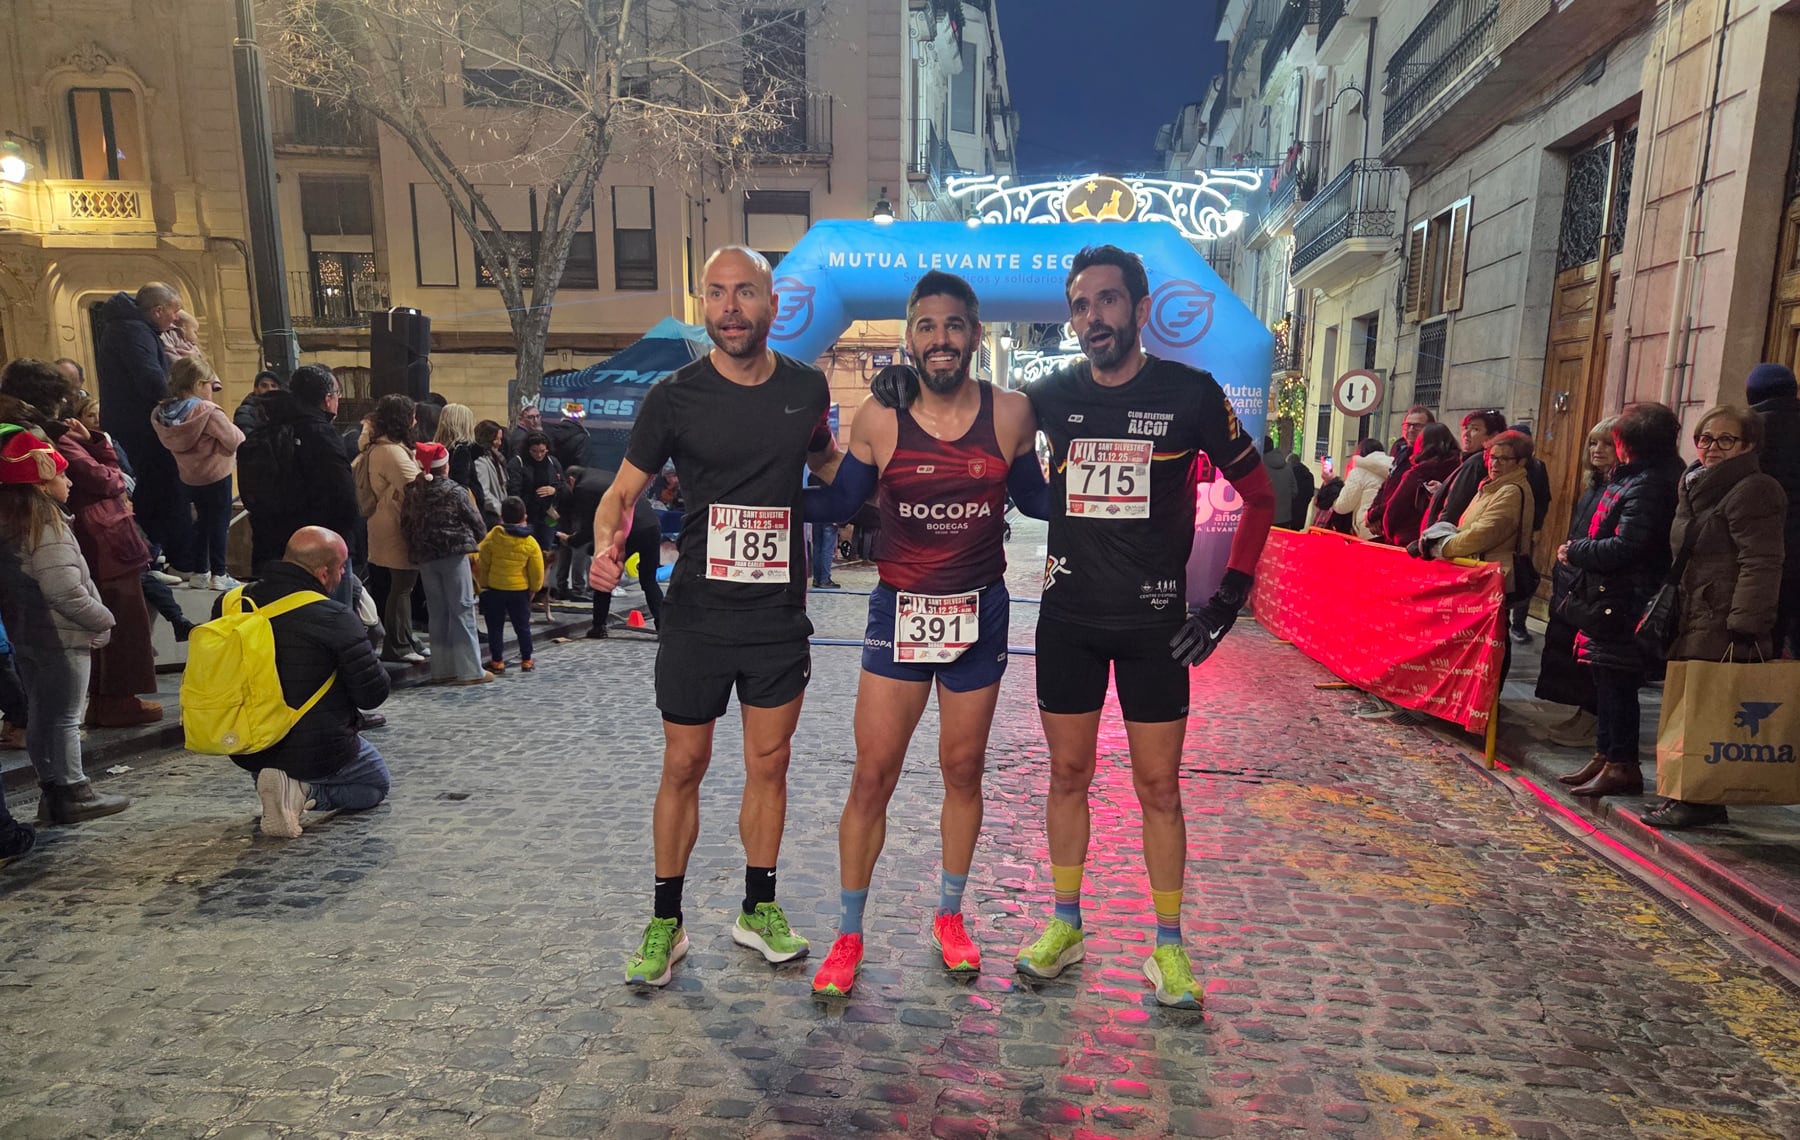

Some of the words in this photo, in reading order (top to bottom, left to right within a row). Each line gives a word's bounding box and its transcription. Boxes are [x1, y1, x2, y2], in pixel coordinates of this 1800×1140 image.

[829, 252, 907, 268] MUTUA
[918, 253, 1020, 269] LEVANTE
[1005, 272, 1064, 284] solidarios
[1128, 419, 1168, 436] ALCOI
[1074, 442, 1096, 461] XIX
[1114, 443, 1145, 452] SILVESTRE
[1081, 464, 1135, 495] 715
[717, 508, 741, 528] XIX
[743, 510, 758, 518] SANT
[759, 511, 784, 519] SILVESTRE
[899, 502, 991, 519] BOCOPA
[742, 520, 772, 529] 31.12.25
[725, 530, 777, 561] 185
[1151, 597, 1168, 605] Alcoi
[928, 605, 958, 615] 31.12.25
[909, 615, 961, 642] 391
[1704, 742, 1797, 764] Joma
